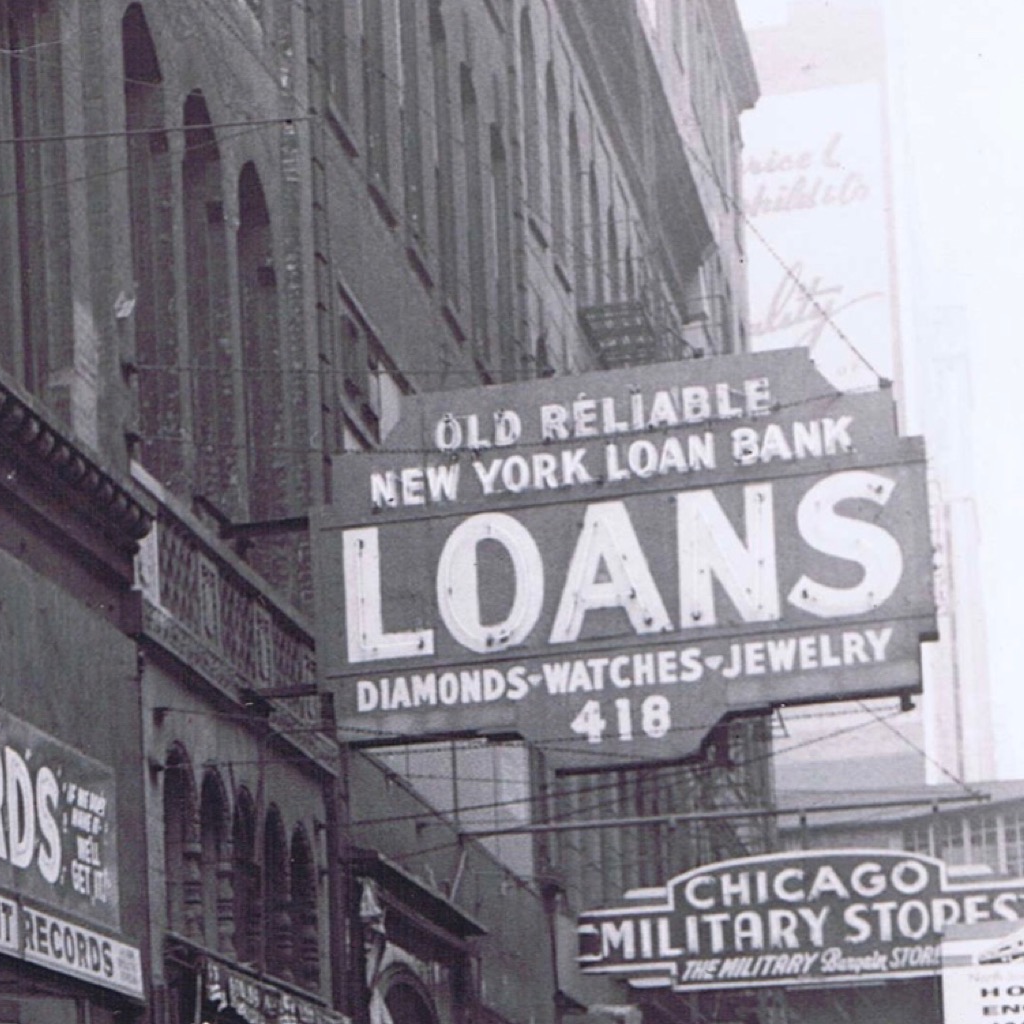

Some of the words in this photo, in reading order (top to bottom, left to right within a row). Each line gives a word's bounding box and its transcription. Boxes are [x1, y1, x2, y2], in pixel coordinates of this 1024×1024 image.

[435, 410, 521, 450] OLD
[542, 376, 772, 442] RELIABLE
[370, 465, 461, 508] NEW
[474, 449, 595, 496] YORK
[607, 431, 716, 481] LOAN
[732, 415, 856, 464] BANK
[341, 469, 905, 664] LOANS
[357, 667, 528, 712] DIAMONDS
[544, 648, 701, 693] WATCHES
[722, 629, 893, 678] JEWELRY
[570, 695, 672, 744] 418
[685, 859, 930, 910] CHICAGO
[24, 909, 114, 978] RECORDS
[602, 906, 832, 960] MILITARY
[682, 959, 719, 981] THE
[718, 951, 820, 980] MILITARY
